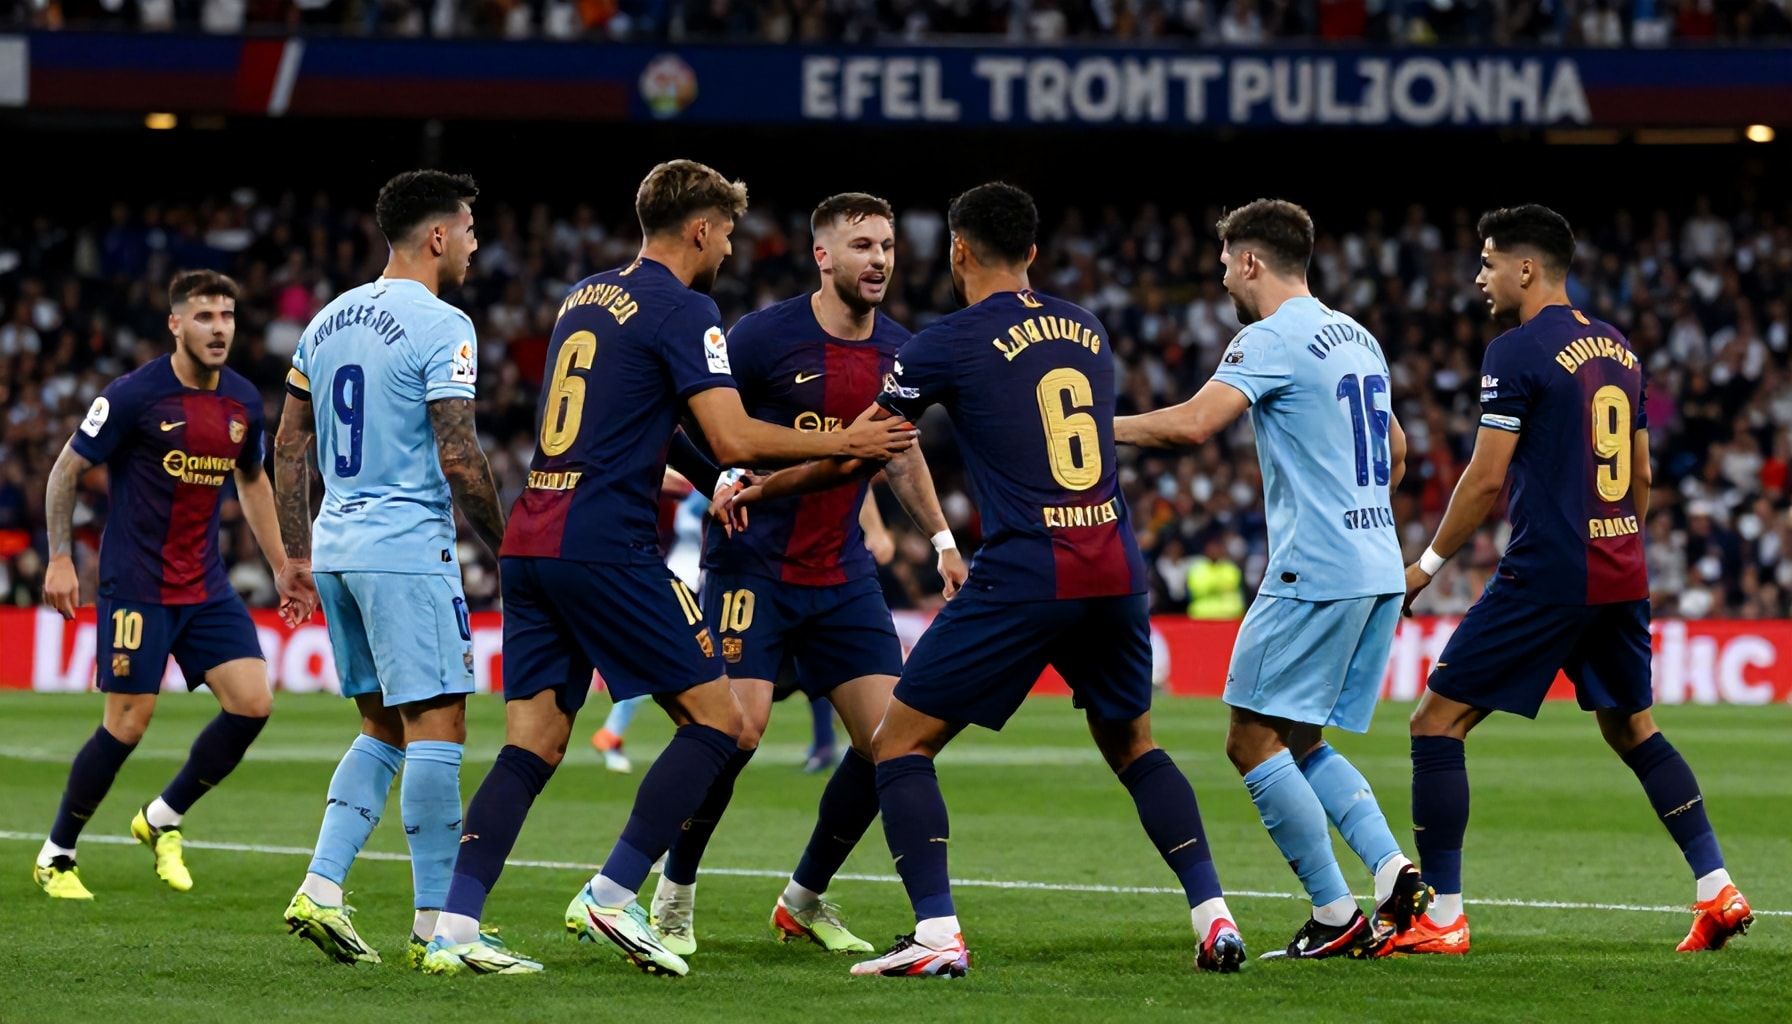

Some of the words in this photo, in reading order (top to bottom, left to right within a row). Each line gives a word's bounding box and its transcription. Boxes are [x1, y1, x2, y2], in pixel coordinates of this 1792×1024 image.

[801, 57, 959, 120] EFEL
[332, 363, 365, 479] 9
[540, 330, 597, 457] 6
[1036, 367, 1102, 491] 6
[1592, 385, 1632, 503] 9
[112, 608, 144, 650] 10
[719, 588, 756, 634] 10
